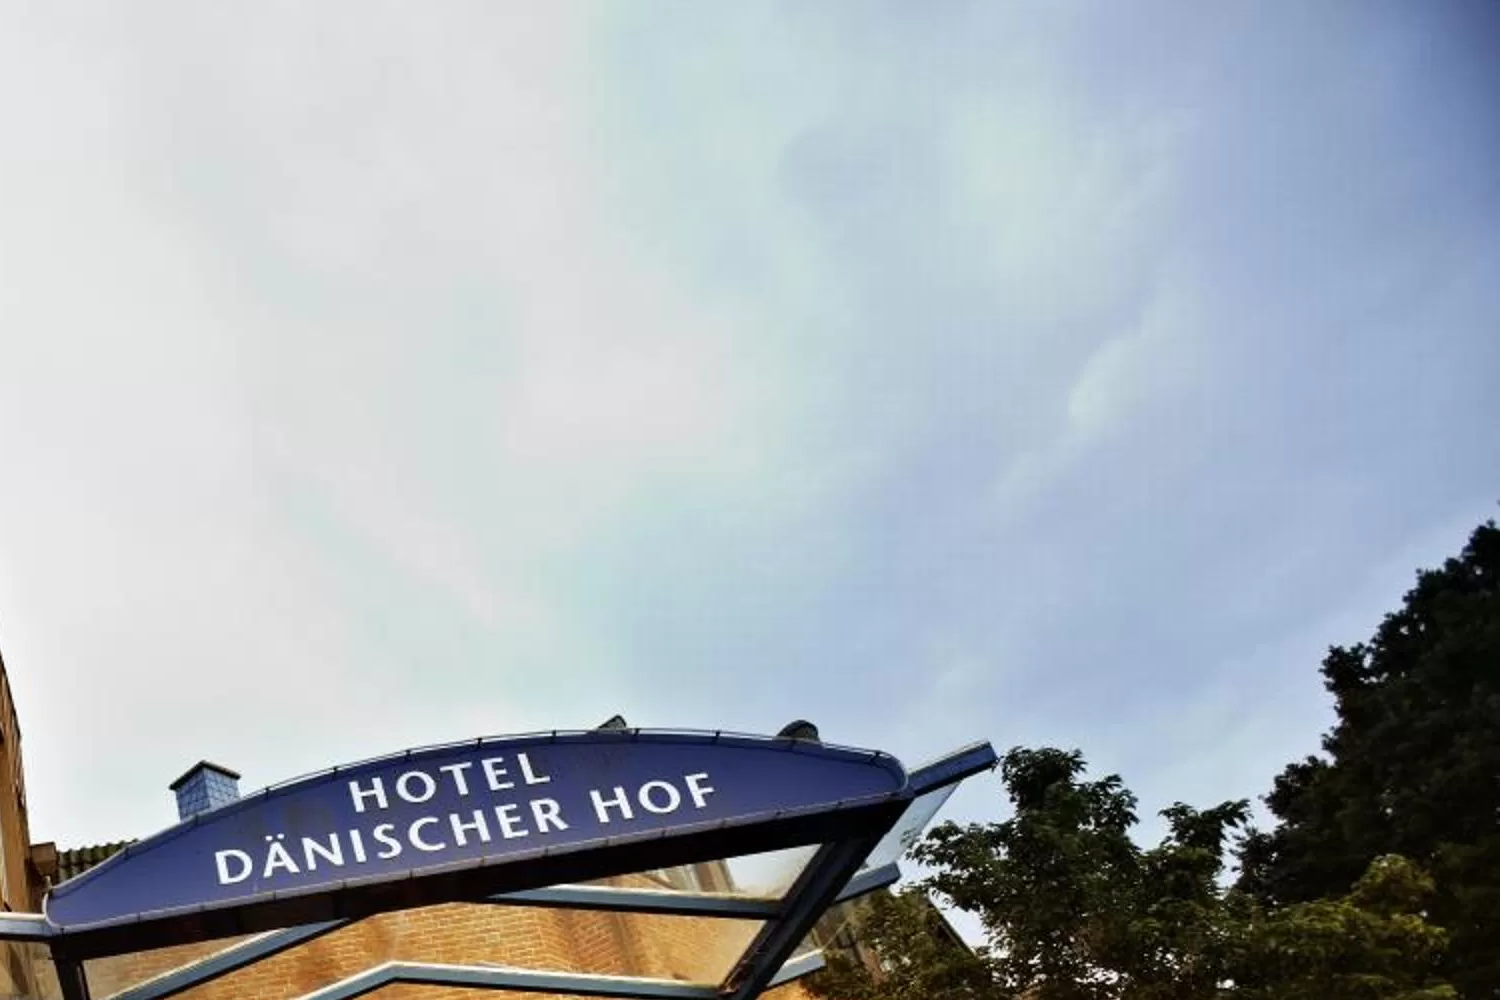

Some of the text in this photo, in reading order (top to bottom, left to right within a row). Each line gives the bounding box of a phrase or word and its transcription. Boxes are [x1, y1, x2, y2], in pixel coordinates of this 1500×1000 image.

[348, 753, 551, 813] HOTEL
[214, 772, 716, 885] DÄNISCHER HOF
